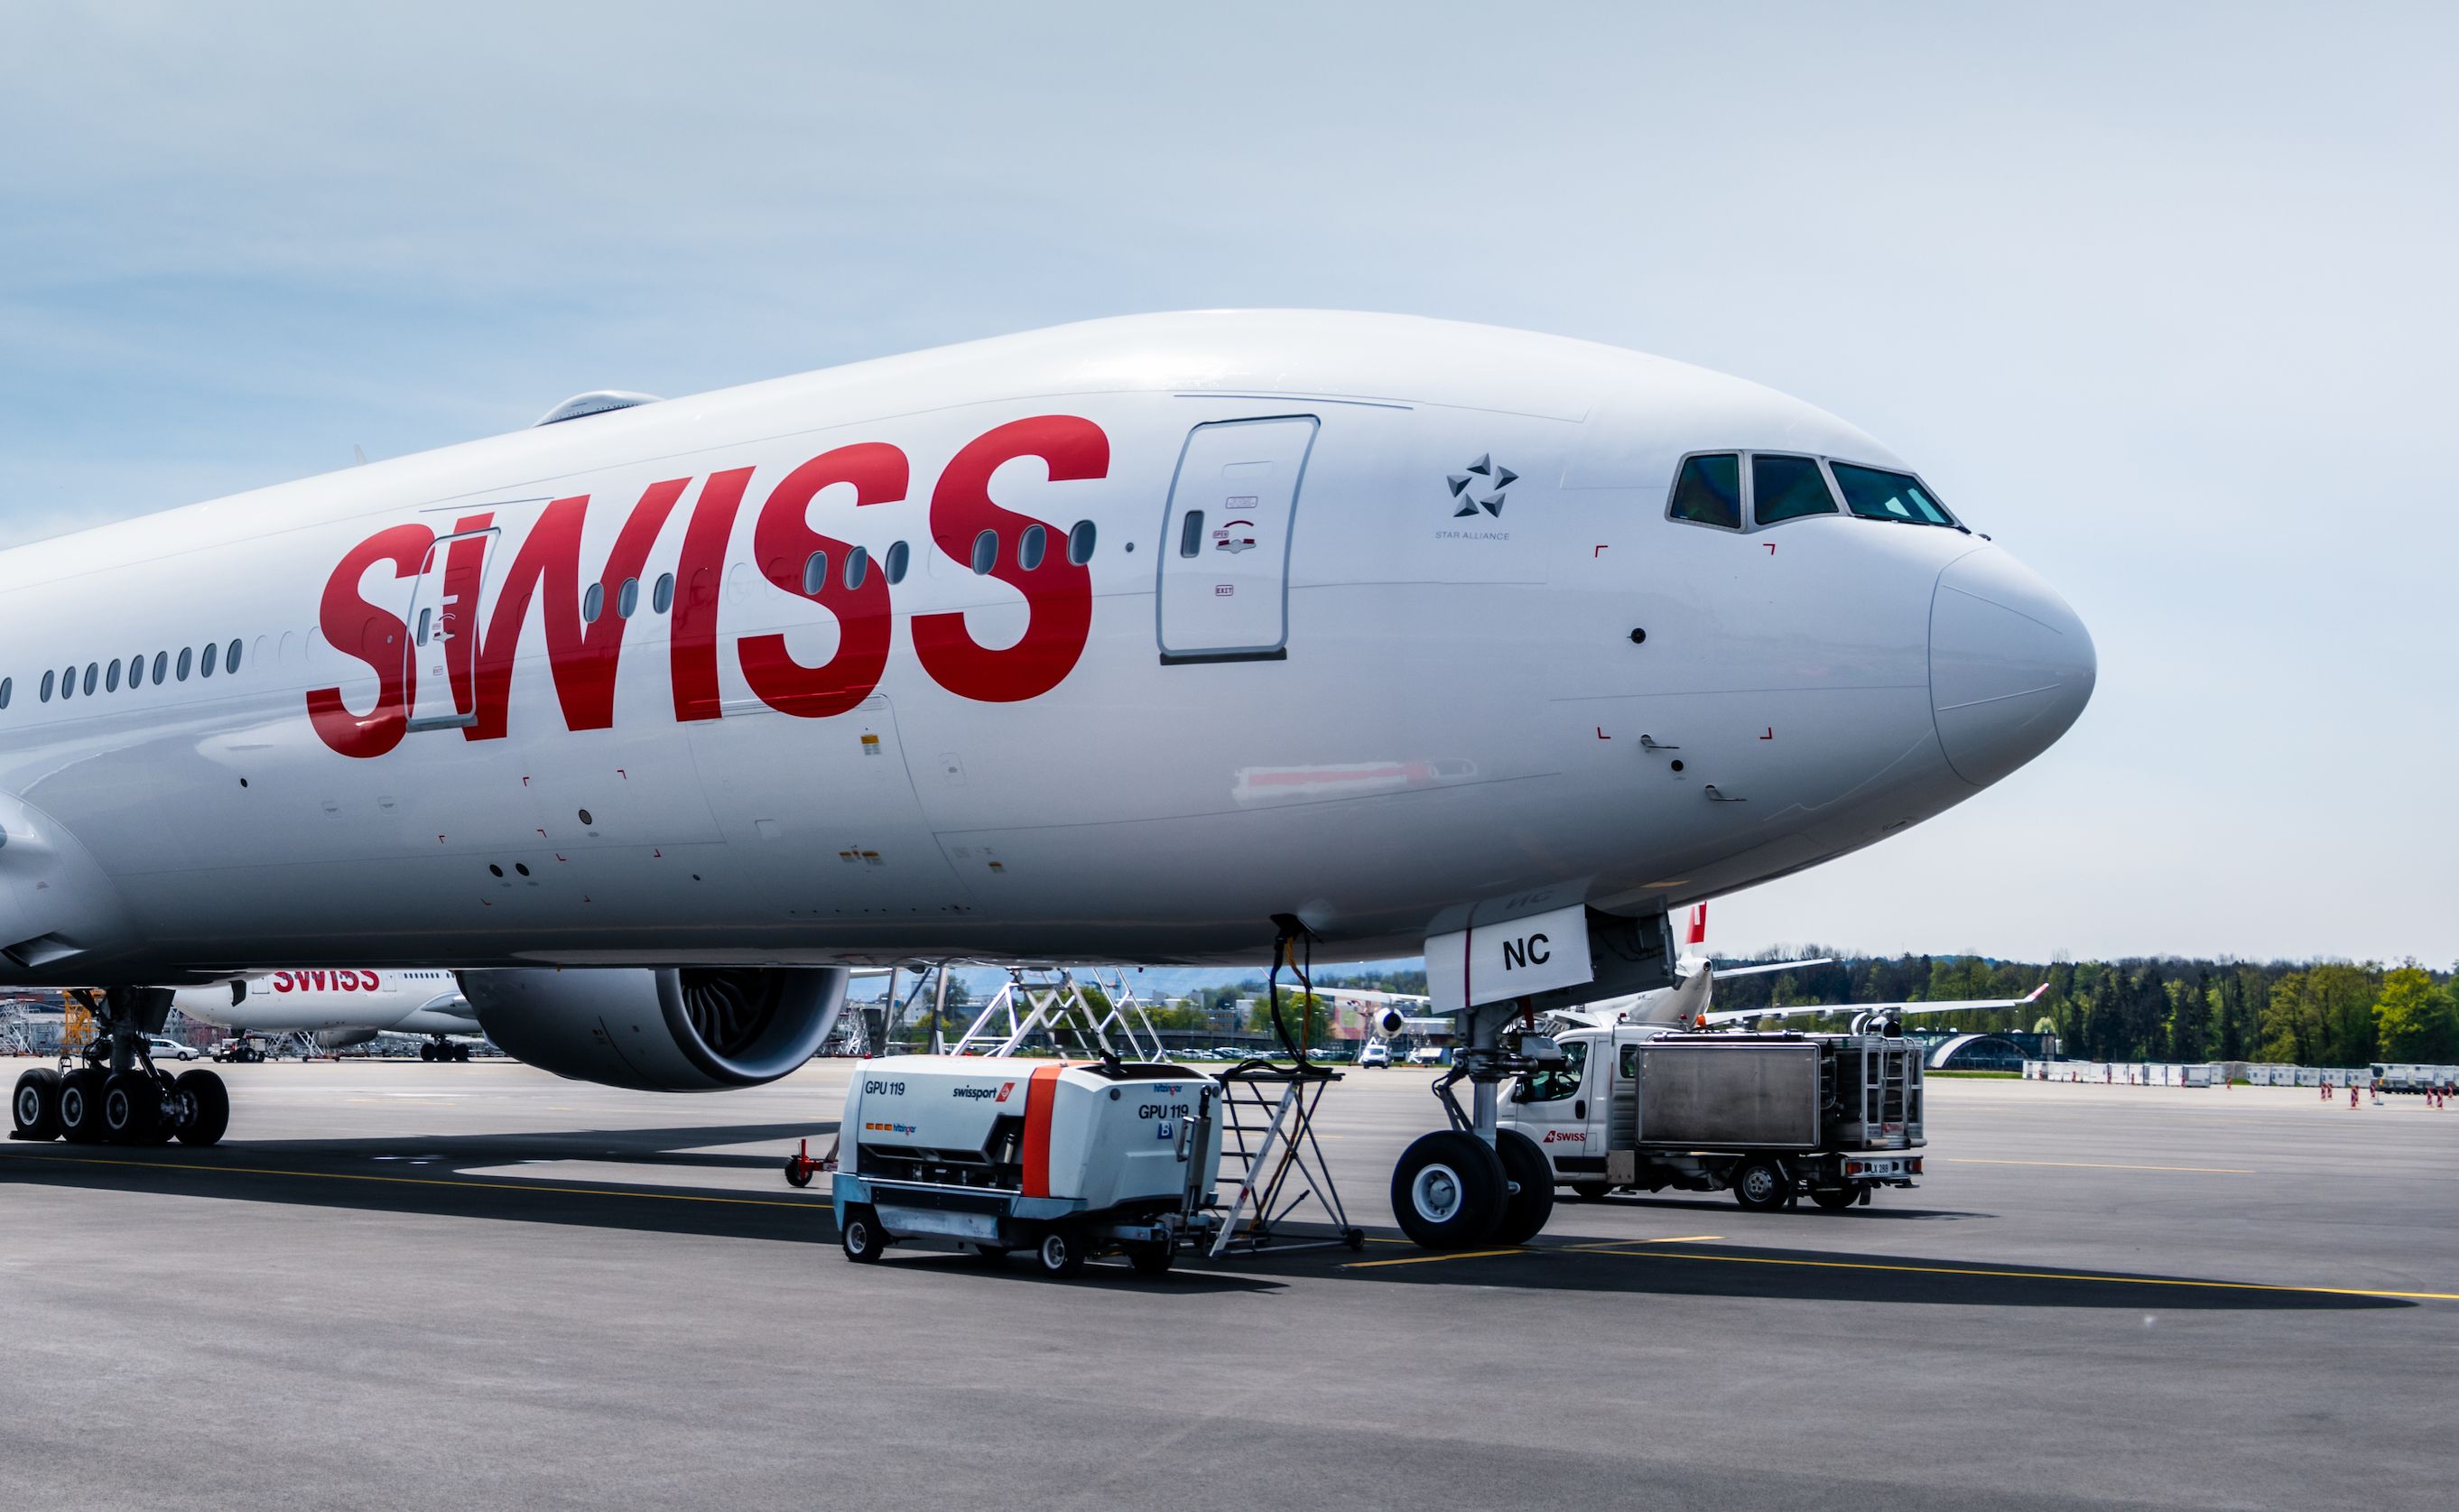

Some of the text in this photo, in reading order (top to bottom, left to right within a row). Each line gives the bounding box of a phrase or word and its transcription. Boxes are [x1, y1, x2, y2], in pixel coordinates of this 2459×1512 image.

[1435, 531, 1509, 541] STAR ALLIANCE
[306, 414, 1111, 758] SWISS
[1503, 933, 1551, 970] NC
[865, 1081, 905, 1096] GPU 119
[952, 1085, 997, 1100] swissport
[1138, 1104, 1189, 1119] GPU 119
[1161, 1123, 1170, 1136] B
[1556, 1132, 1586, 1142] SWISS
